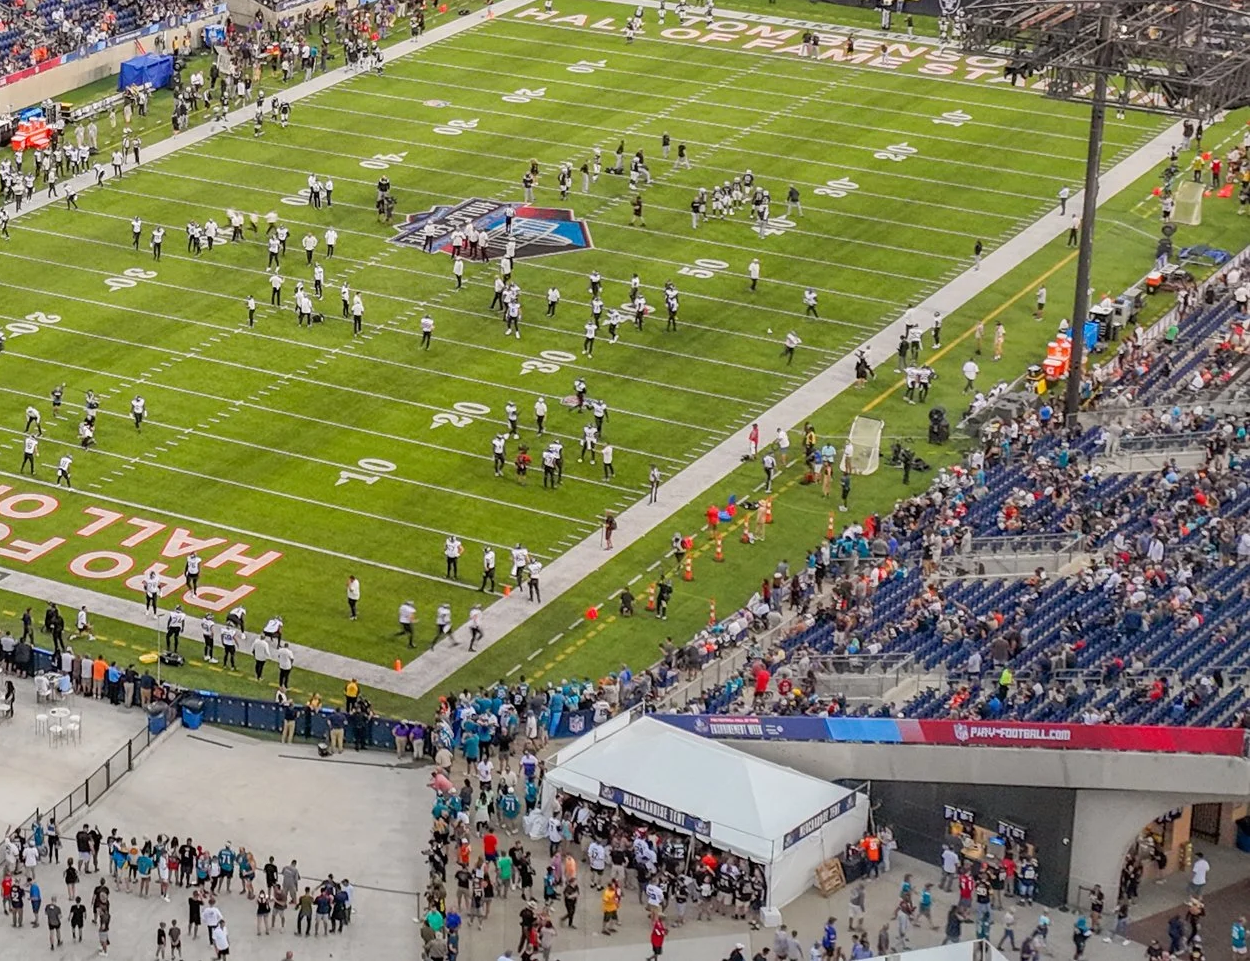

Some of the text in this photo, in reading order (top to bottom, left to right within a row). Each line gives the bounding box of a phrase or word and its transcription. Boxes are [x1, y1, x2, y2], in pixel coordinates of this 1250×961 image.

[681, 16, 799, 39] TOM
[661, 28, 739, 43] OF
[742, 38, 907, 69] FAME
[874, 144, 918, 161] 20
[814, 179, 859, 197] 30
[104, 268, 157, 288] 30
[679, 259, 729, 278] 50
[6, 312, 61, 335] 20
[530, 350, 576, 373] 30
[438, 402, 491, 428] 20
[343, 458, 397, 485] 10
[76, 506, 283, 577] HALL
[69, 550, 256, 612] PRO
[623, 792, 685, 826] MERCHANDISE TENT
[800, 802, 841, 837] MERCHANDISE TENT
